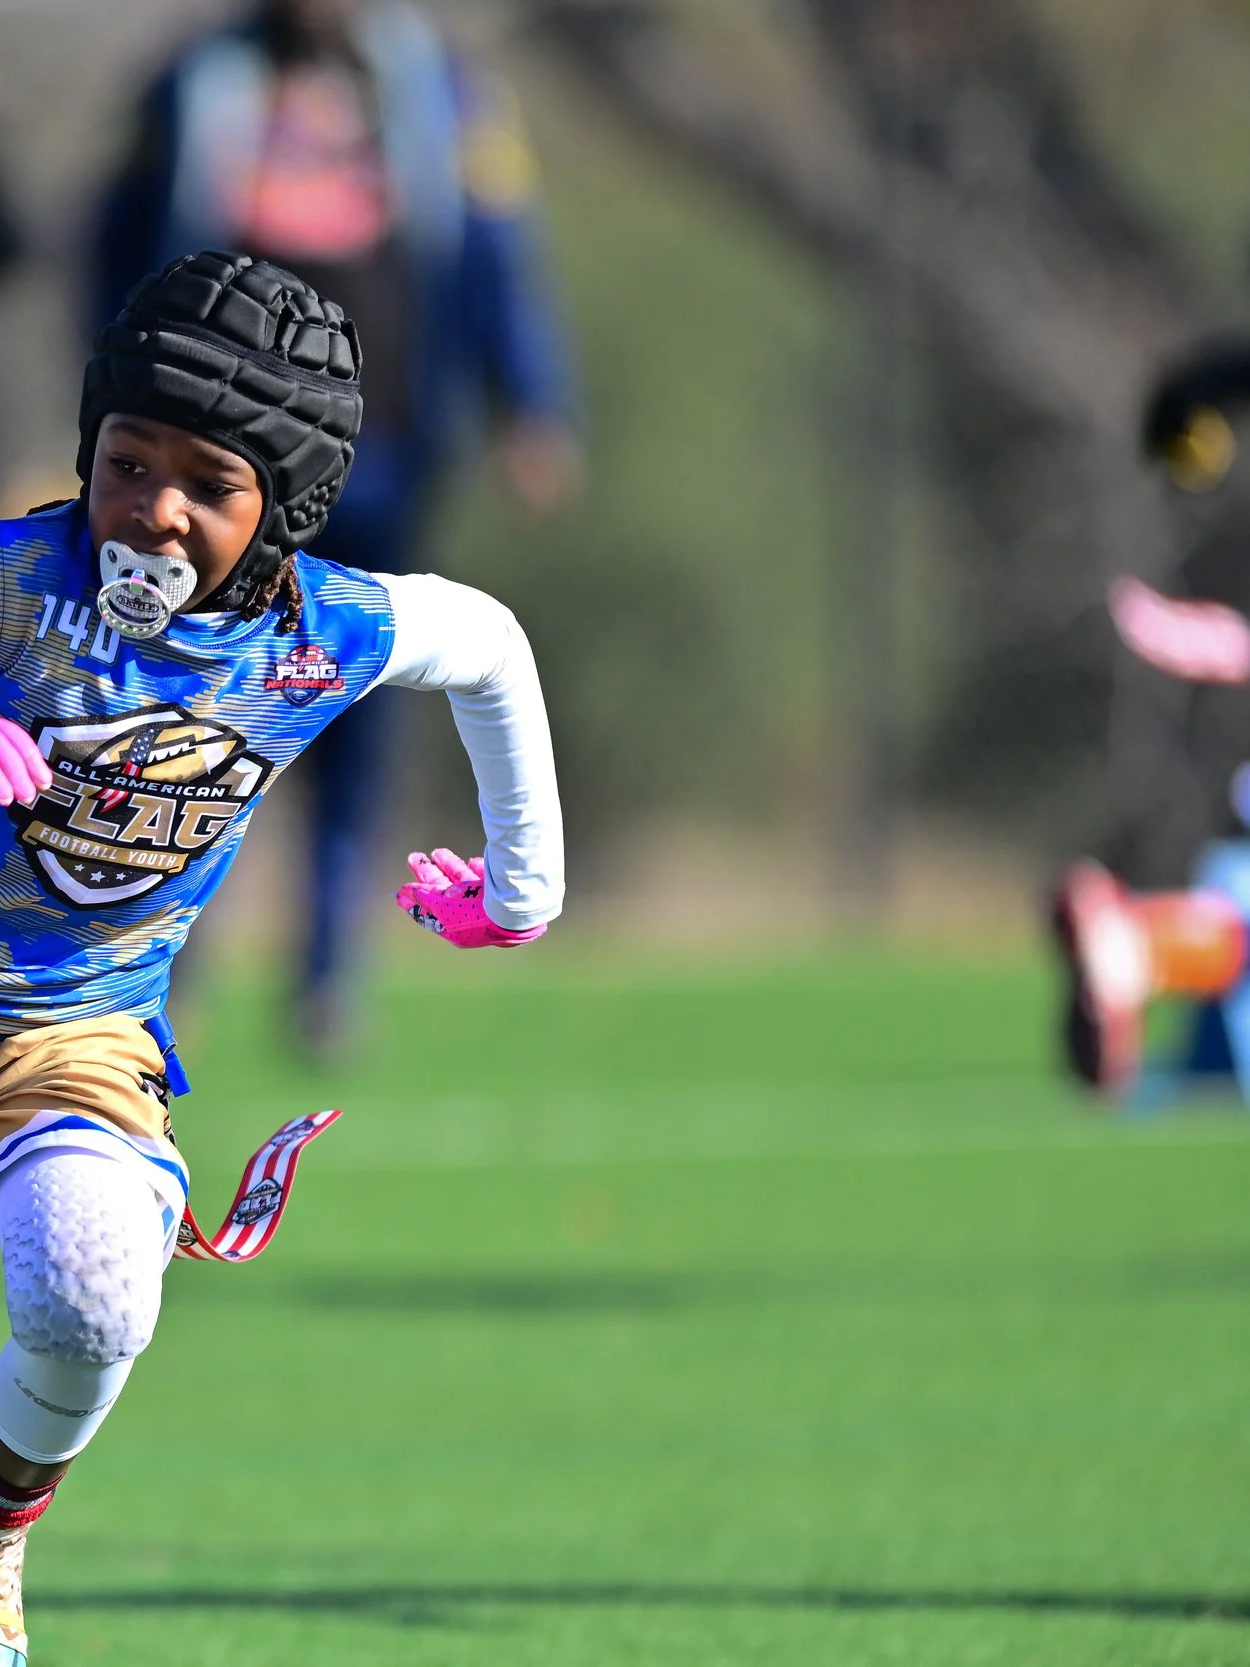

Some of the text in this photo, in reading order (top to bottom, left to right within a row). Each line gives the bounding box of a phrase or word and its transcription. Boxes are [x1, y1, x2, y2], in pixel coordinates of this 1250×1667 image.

[36, 593, 121, 664] 140
[265, 679, 343, 689] NATIONALS
[276, 663, 337, 681] FLAG
[57, 759, 226, 798] ALL-AMERICAN
[16, 772, 242, 850] FLAG
[39, 825, 178, 867] FOOTBALL YOUTH
